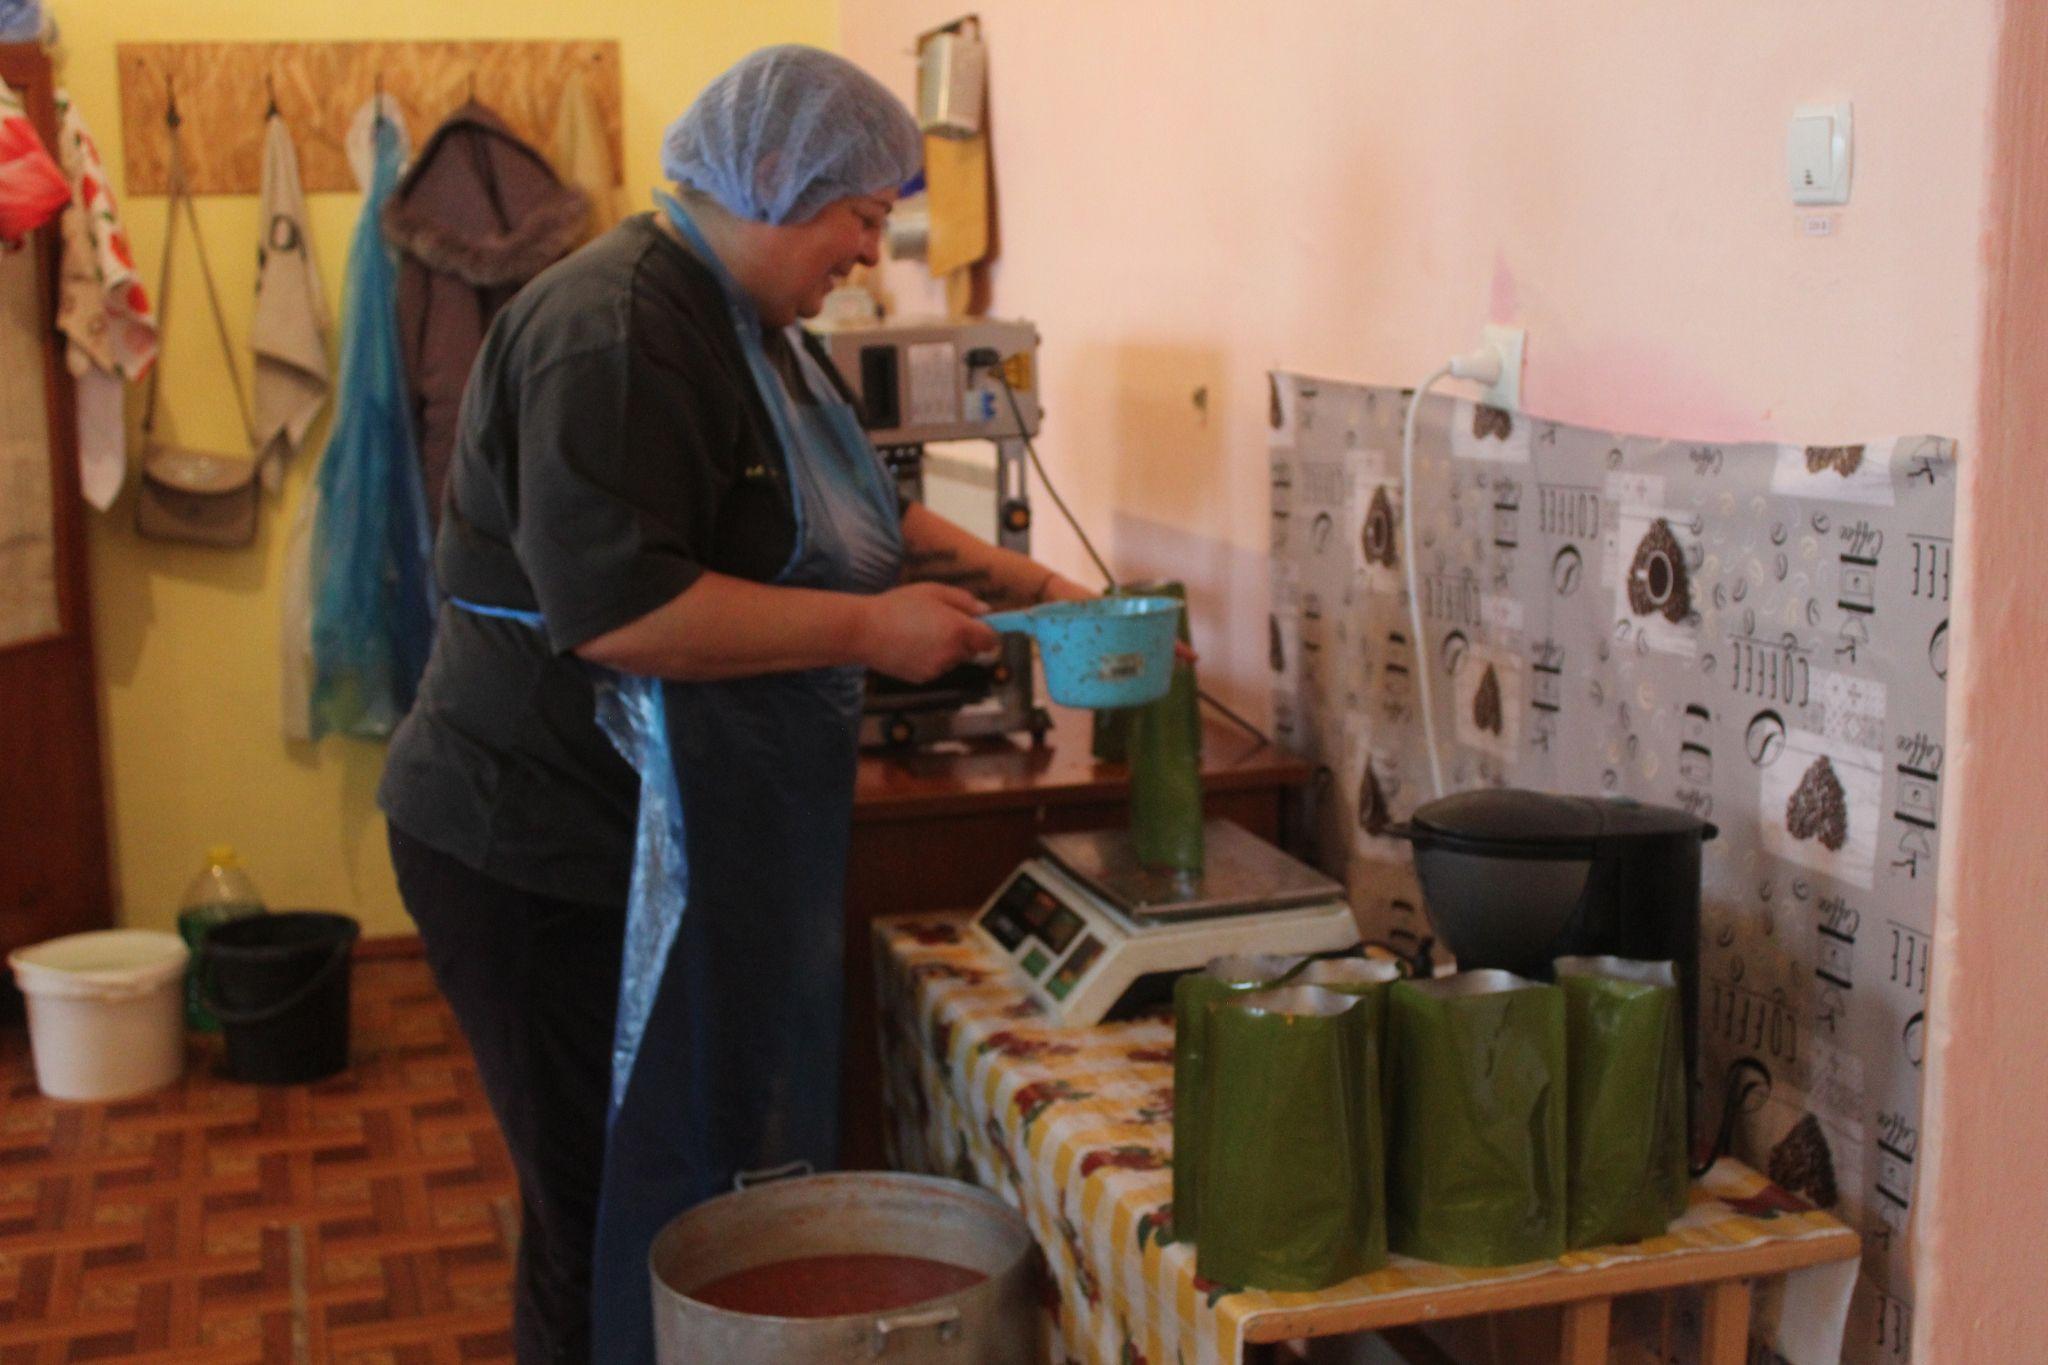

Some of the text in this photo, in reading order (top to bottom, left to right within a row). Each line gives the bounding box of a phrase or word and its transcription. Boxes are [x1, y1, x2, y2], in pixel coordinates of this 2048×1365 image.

[1840, 520, 1884, 556] Coffee
[1732, 641, 1809, 708] COFFEE
[1896, 731, 1944, 769] Coffee
[1818, 895, 1861, 936] Coffee
